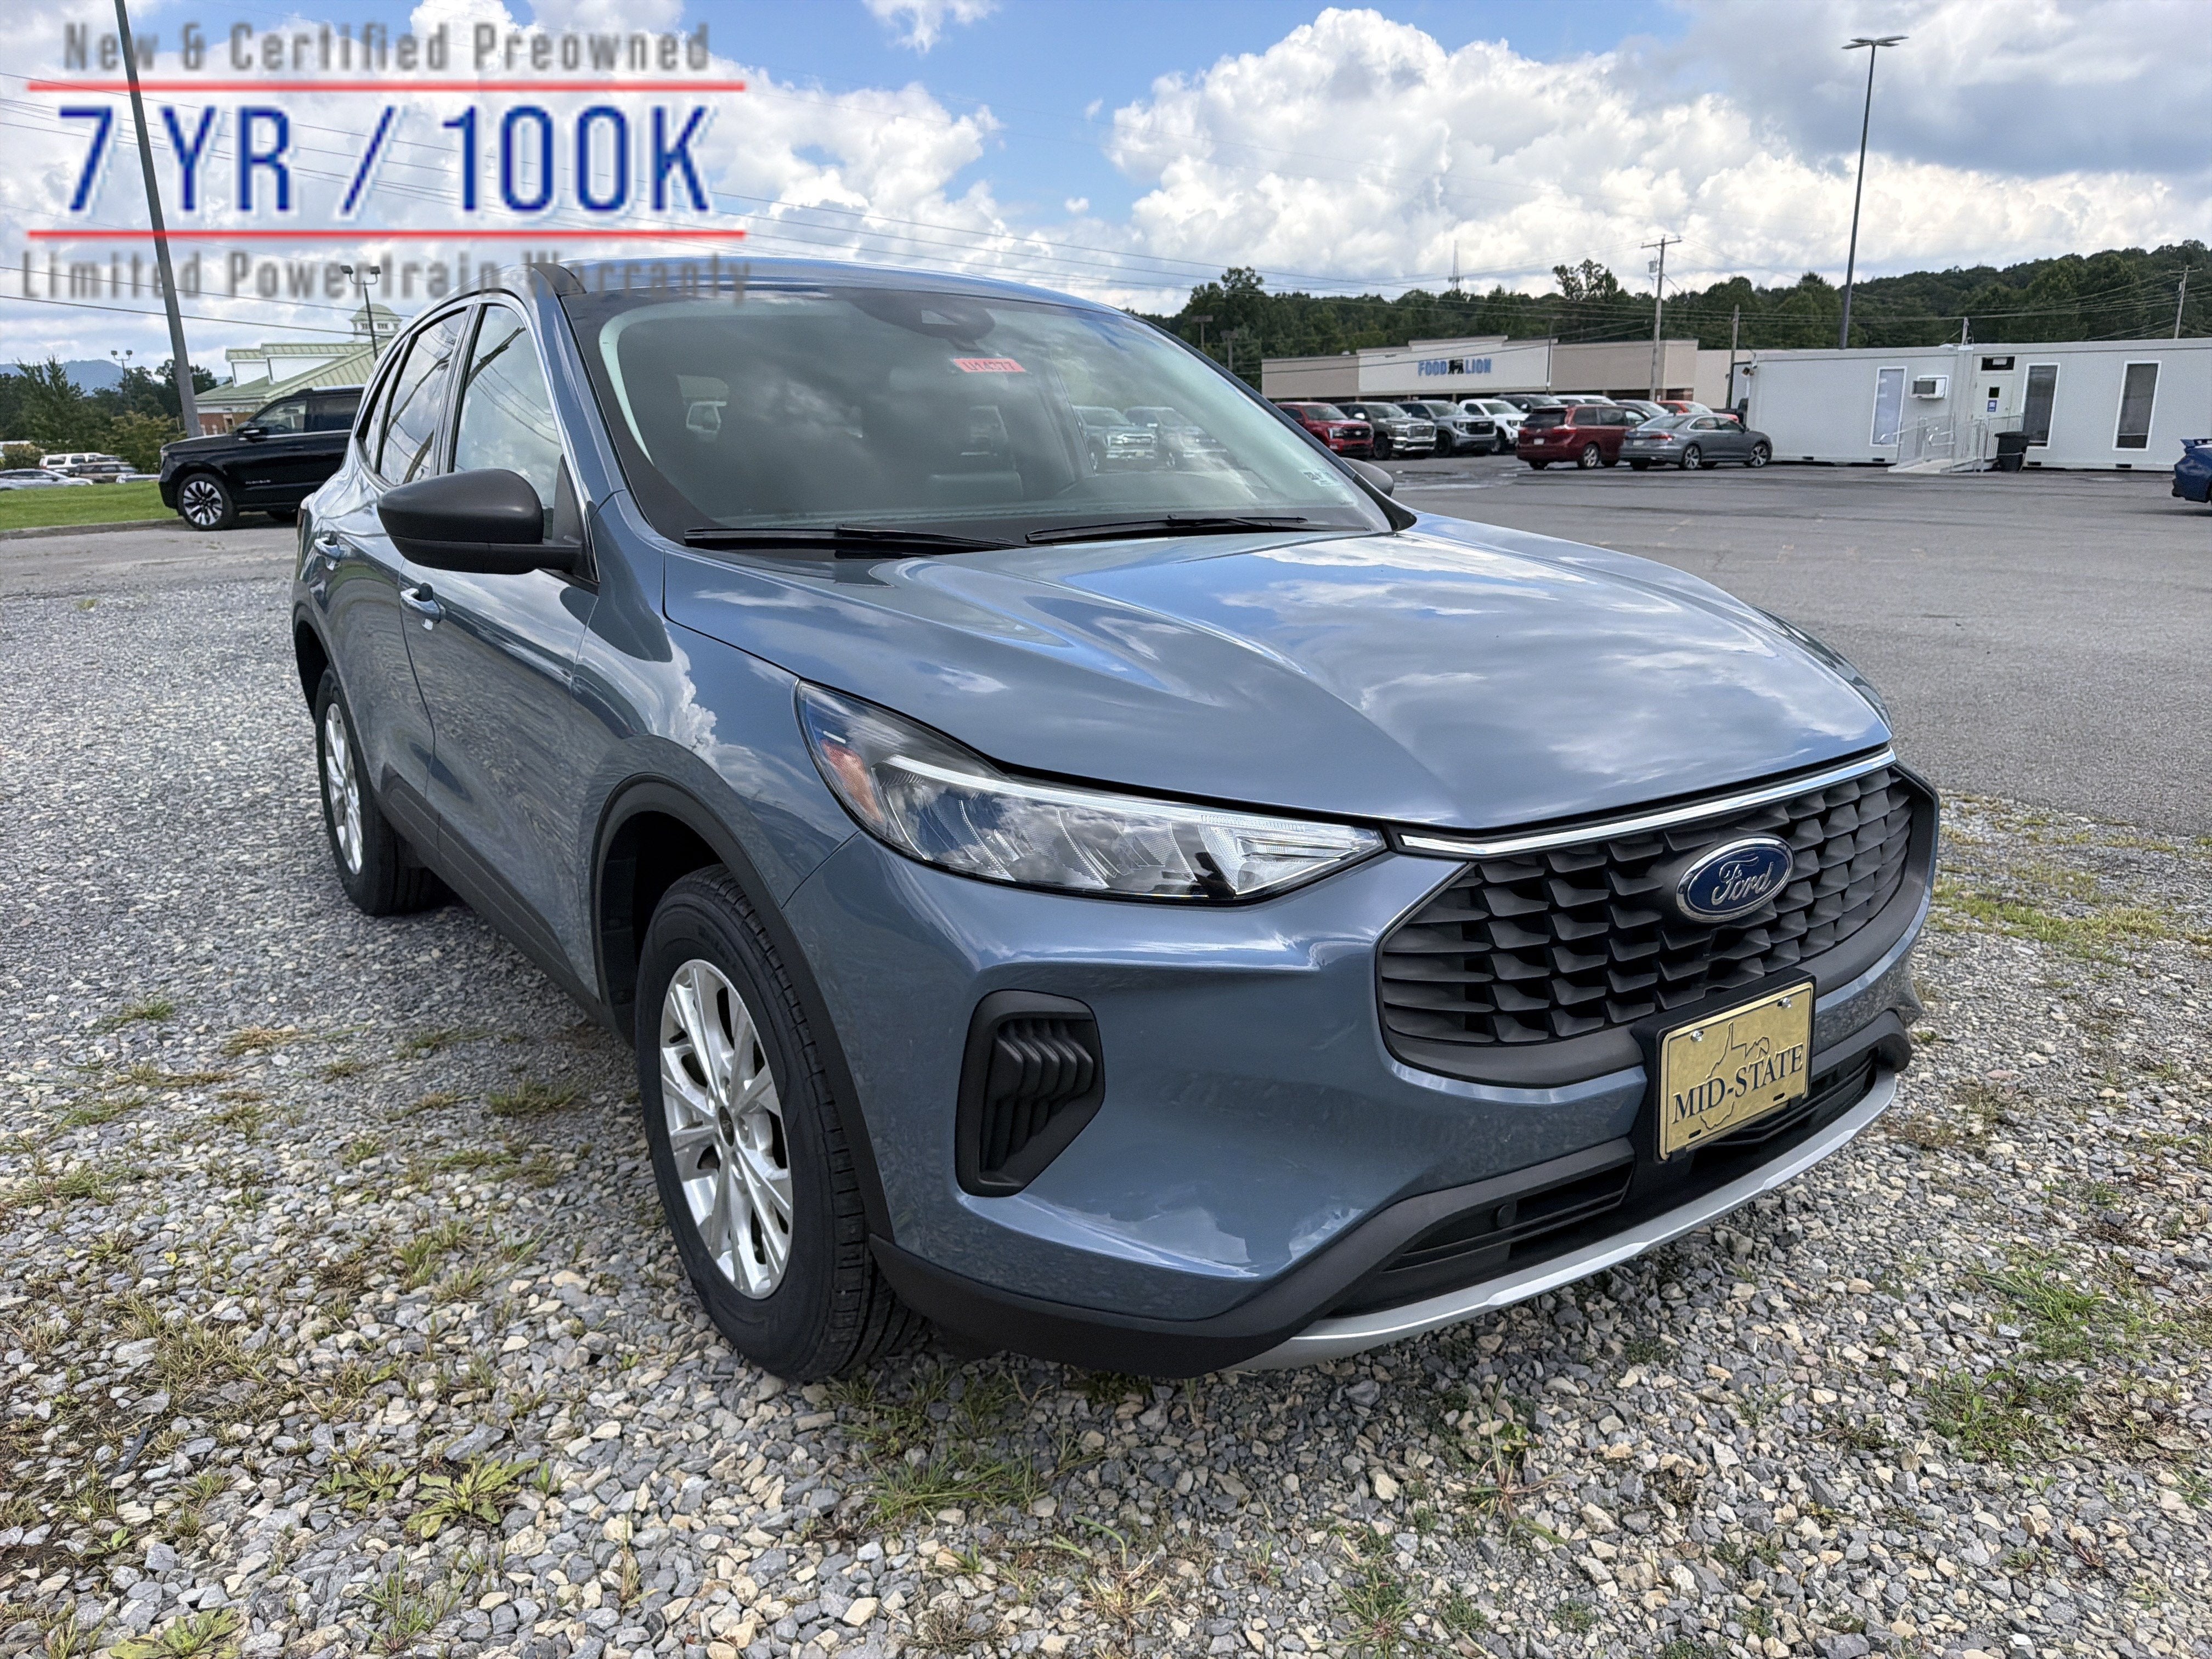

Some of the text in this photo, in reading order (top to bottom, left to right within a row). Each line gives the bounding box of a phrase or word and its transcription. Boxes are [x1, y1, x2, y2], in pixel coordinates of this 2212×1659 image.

[1418, 358, 1492, 376] FOOD LION
[1711, 856, 1774, 906] Ford
[1671, 1041, 1804, 1124] MID-STATE
